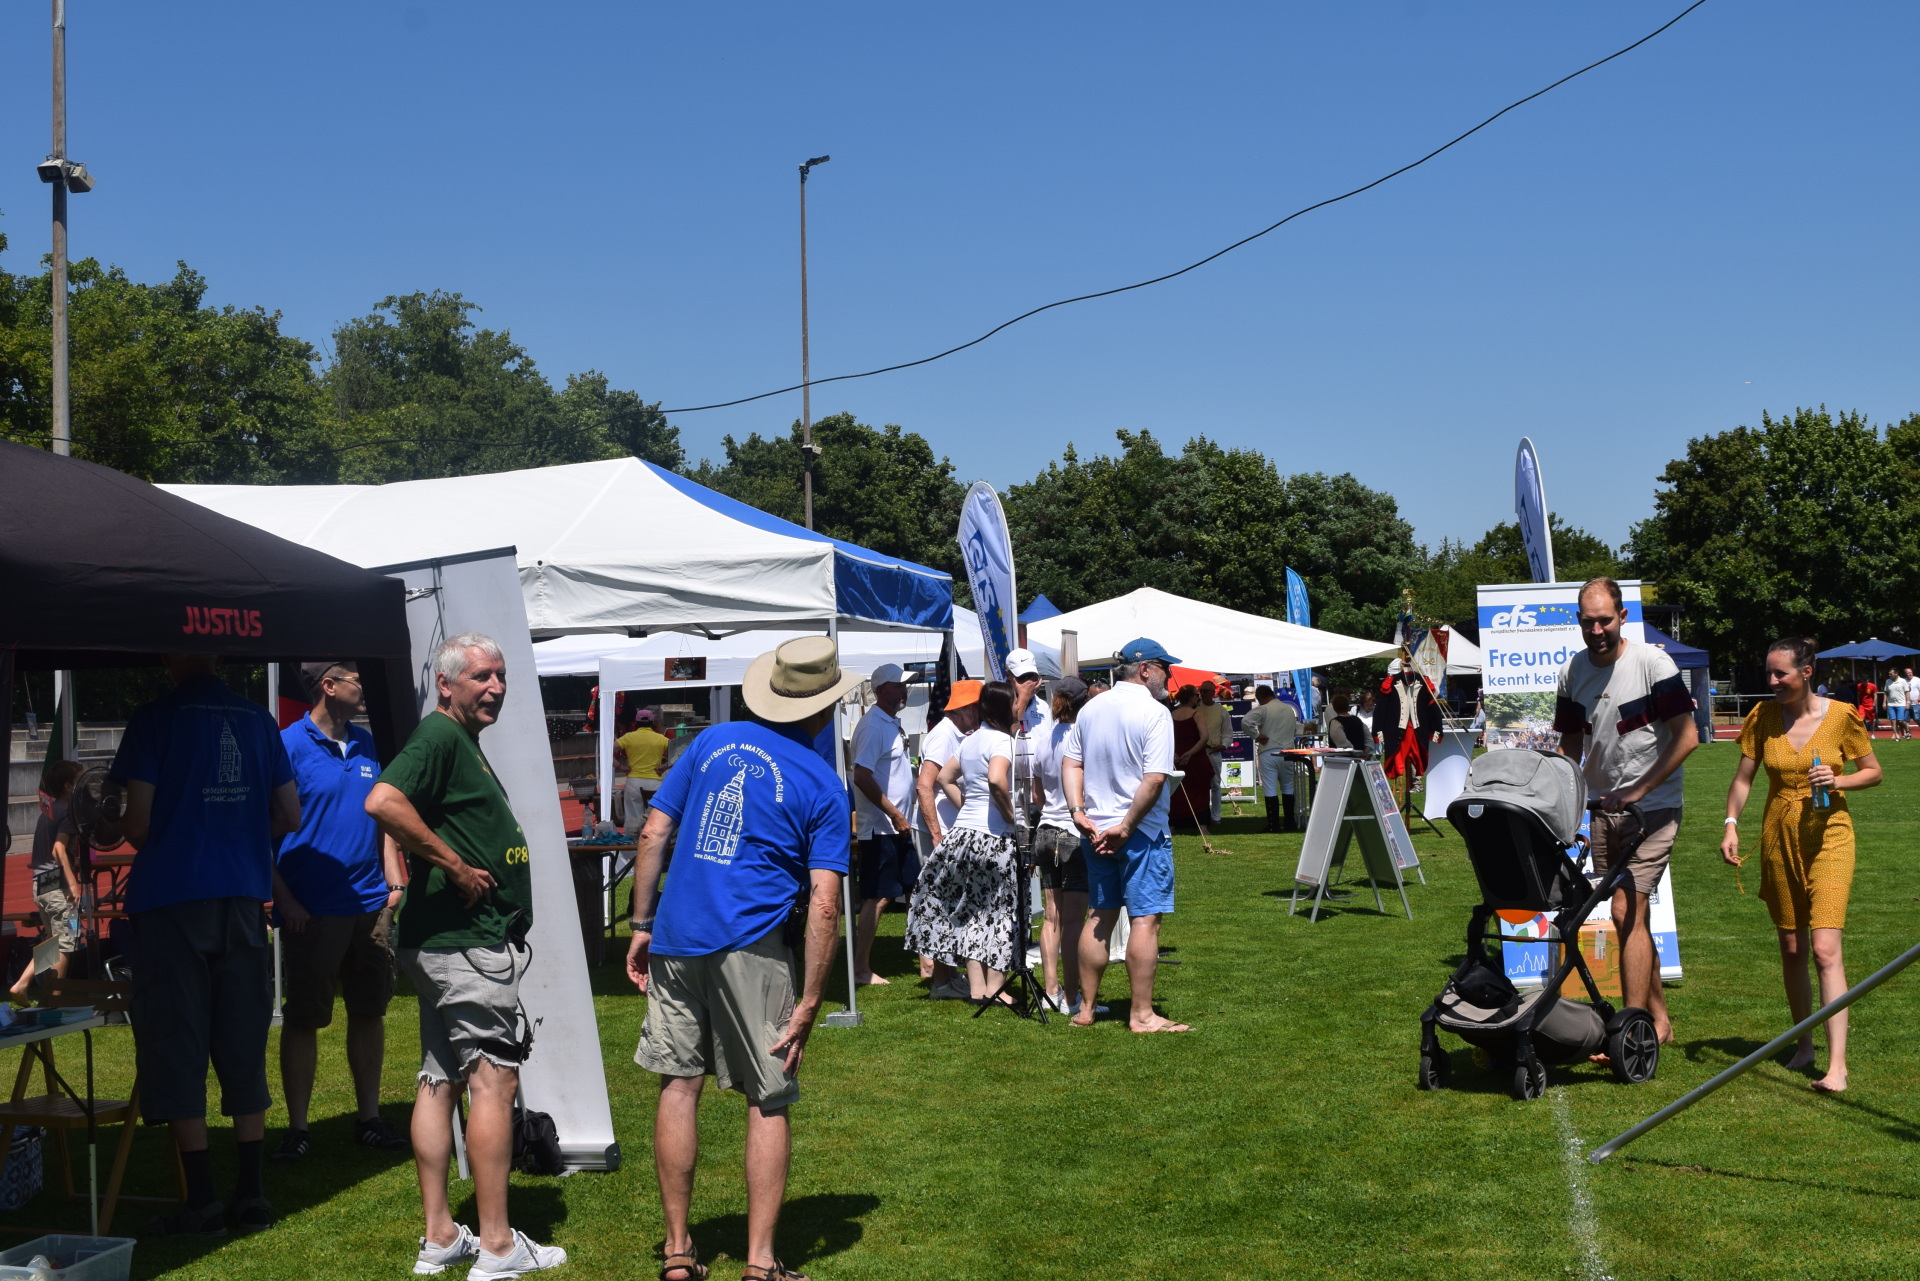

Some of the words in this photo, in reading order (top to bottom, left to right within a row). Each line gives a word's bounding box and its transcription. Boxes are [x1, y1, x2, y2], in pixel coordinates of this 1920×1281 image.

[182, 606, 263, 637] JUSTUS
[1491, 605, 1538, 628] efs
[1488, 673, 1530, 687] kennt
[700, 743, 736, 773] DEUTSCHER
[739, 743, 784, 803] AMATEUR-RADIO-CLUB
